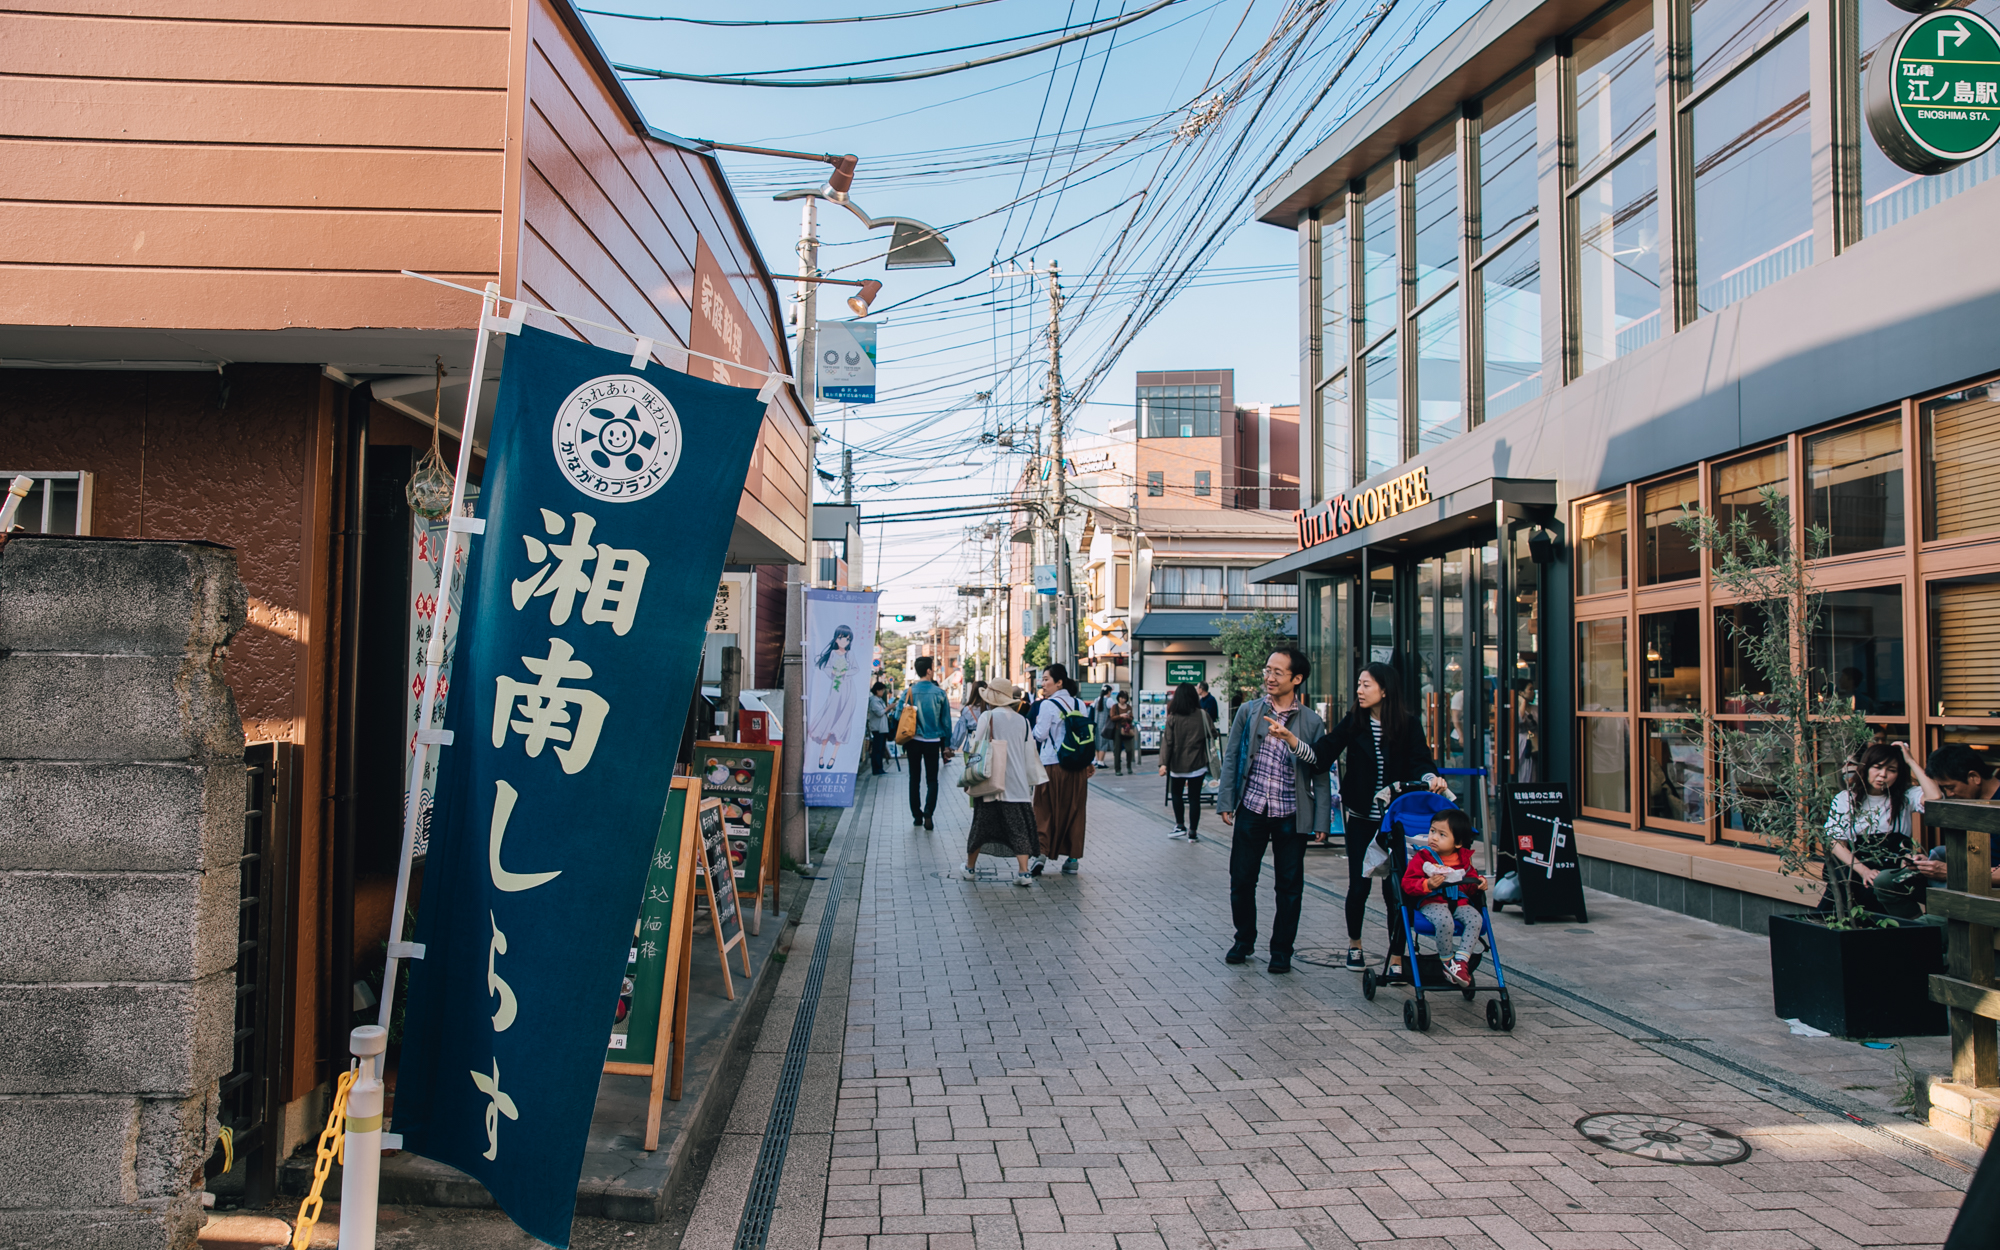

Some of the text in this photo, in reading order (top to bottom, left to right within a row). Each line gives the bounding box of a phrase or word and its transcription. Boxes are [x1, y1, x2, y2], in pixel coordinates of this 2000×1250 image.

[1902, 64, 1934, 77] 江ノ電
[1907, 79, 1998, 104] 江ノ島駅
[1917, 110, 1990, 121] ENOSHIMA STA.
[701, 274, 743, 364] 家庭料理
[578, 382, 671, 434] ふれあい 味わい
[560, 440, 663, 496] かながわブランド
[1352, 465, 1431, 530] COFFEE
[418, 530, 463, 570] 生しす
[1187, 669, 1201, 677] Shop
[803, 774, 848, 784] 019.6.15
[811, 785, 846, 793] SCREEN
[1514, 791, 1563, 800] 駐輪場のご案内
[471, 508, 650, 1162] 湘南しらす
[640, 848, 673, 959] 税込価格
